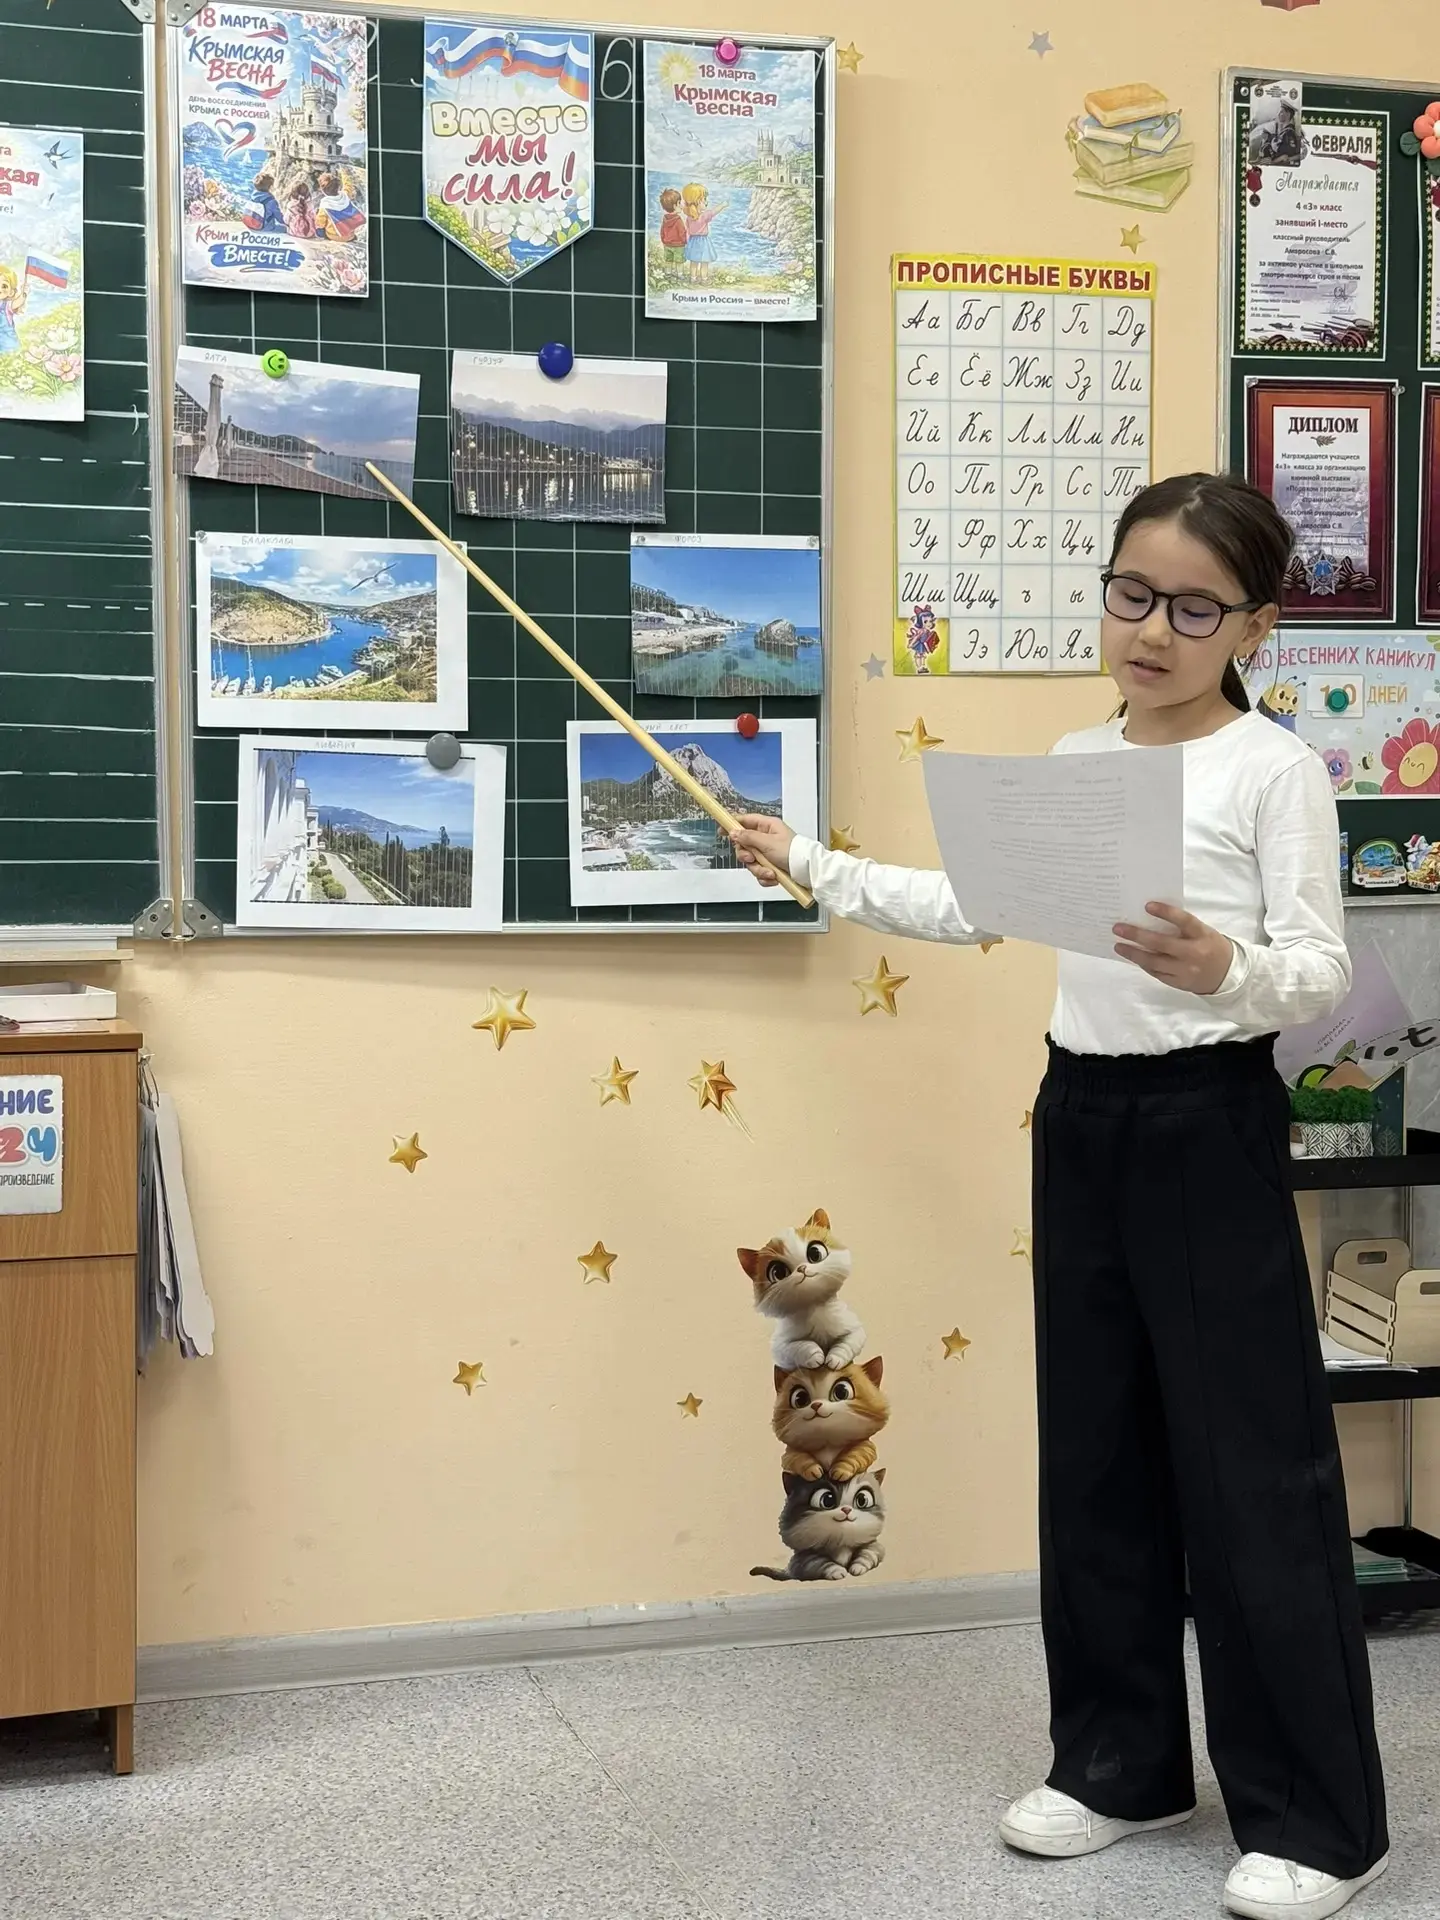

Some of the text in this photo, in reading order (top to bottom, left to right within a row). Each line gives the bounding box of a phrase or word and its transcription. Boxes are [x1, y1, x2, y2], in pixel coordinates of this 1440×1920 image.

[196, 8, 269, 29] 18 МАРТА
[698, 64, 756, 81] 18 марта
[674, 84, 778, 107] Крымская
[189, 104, 270, 120] КРЫМА С РОССИЕЙ
[430, 101, 588, 137] Вместе
[695, 101, 754, 118] весна
[466, 134, 548, 166] мы
[1312, 134, 1373, 154] ФЕВРАЛЯ
[442, 151, 576, 205] сила!
[1276, 171, 1360, 196] Награждается
[1275, 219, 1316, 228] занявший
[1305, 236, 1350, 244] руководитель
[897, 261, 1151, 291] ПРОПИСНЫЕ БУКВЫ
[672, 293, 698, 303] Крым
[709, 295, 744, 304] Россия
[754, 297, 790, 305] вместе!
[1287, 416, 1359, 435] ДИПЛОМ
[1251, 646, 1436, 672] ДО ВЕСЕННИХ КАНИКУЛ
[1367, 681, 1409, 705] ДНЕЙ
